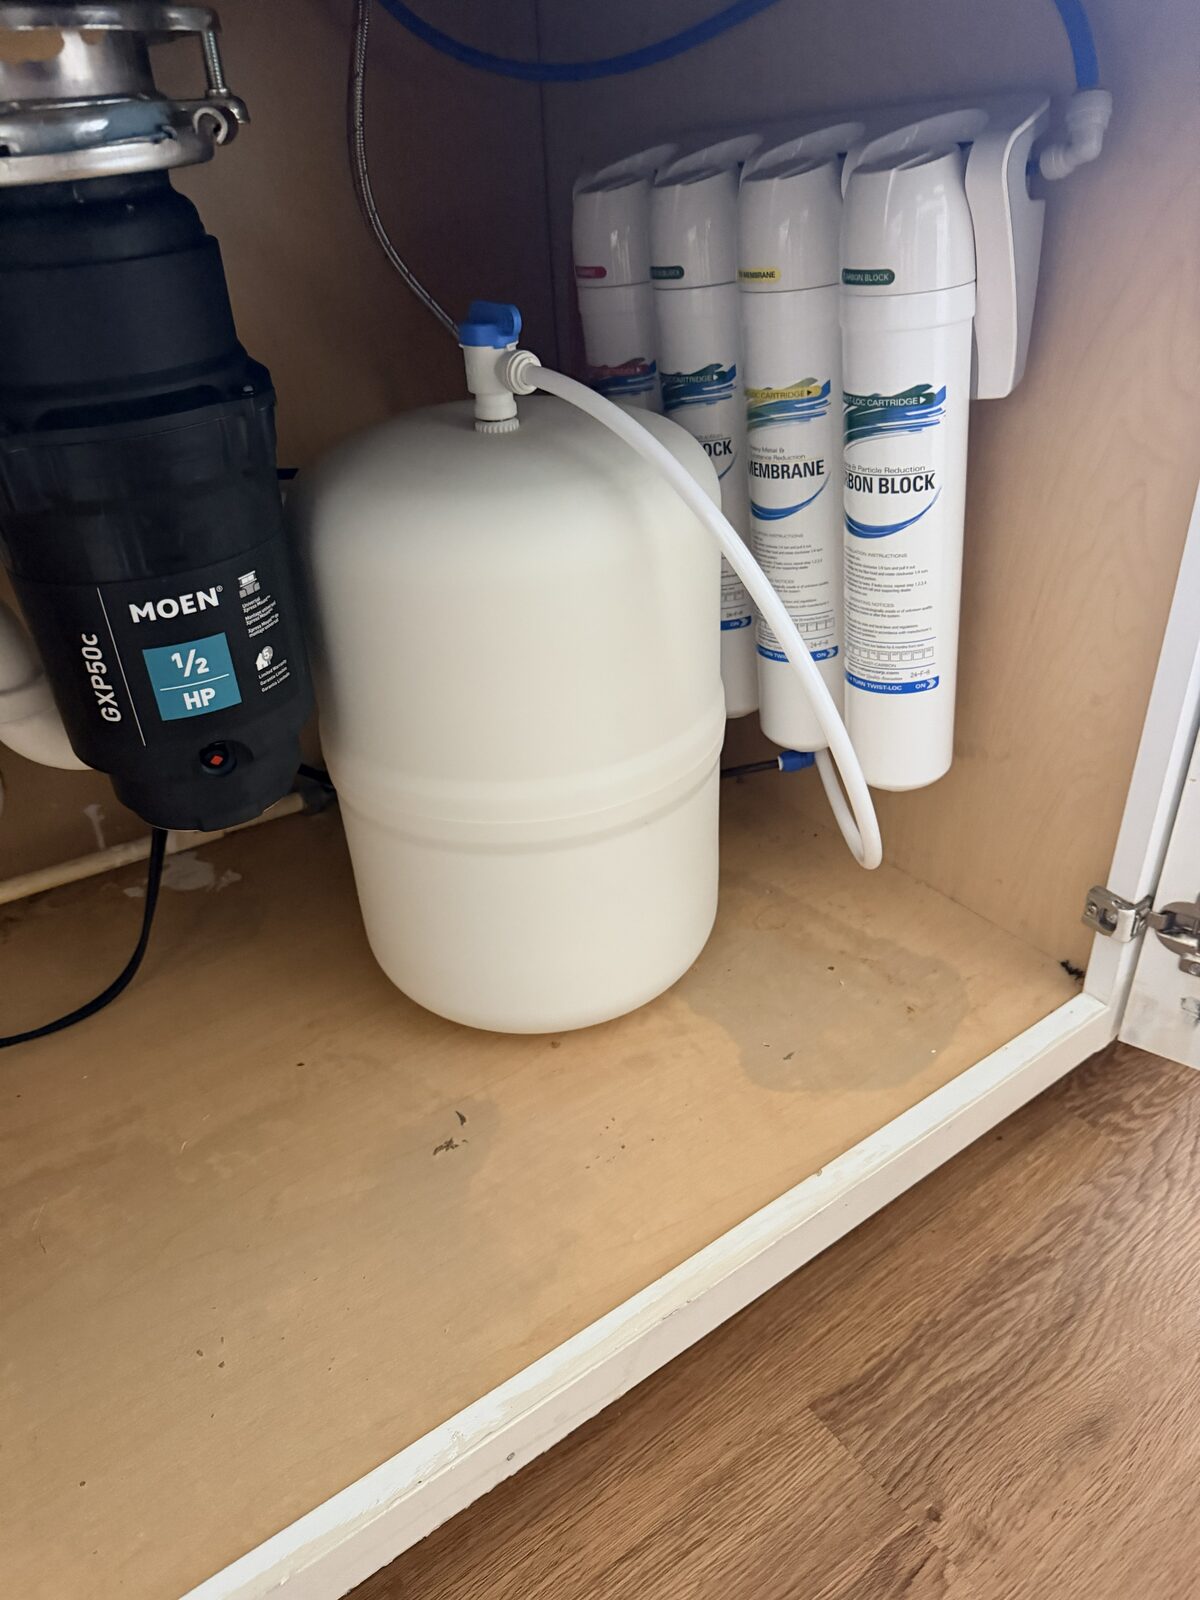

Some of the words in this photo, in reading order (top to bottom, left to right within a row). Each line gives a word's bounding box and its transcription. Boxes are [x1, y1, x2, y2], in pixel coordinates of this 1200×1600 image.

[864, 273, 889, 282] BLOCK
[761, 390, 805, 400] CARTRIDGE
[867, 397, 918, 407] CARTRIDGE
[858, 465, 882, 473] Particle
[884, 466, 926, 474] Reduction
[844, 472, 873, 494] BON
[879, 473, 936, 494] BLOCK
[867, 683, 902, 691] TWIST-LOC
[183, 687, 216, 711] HP
